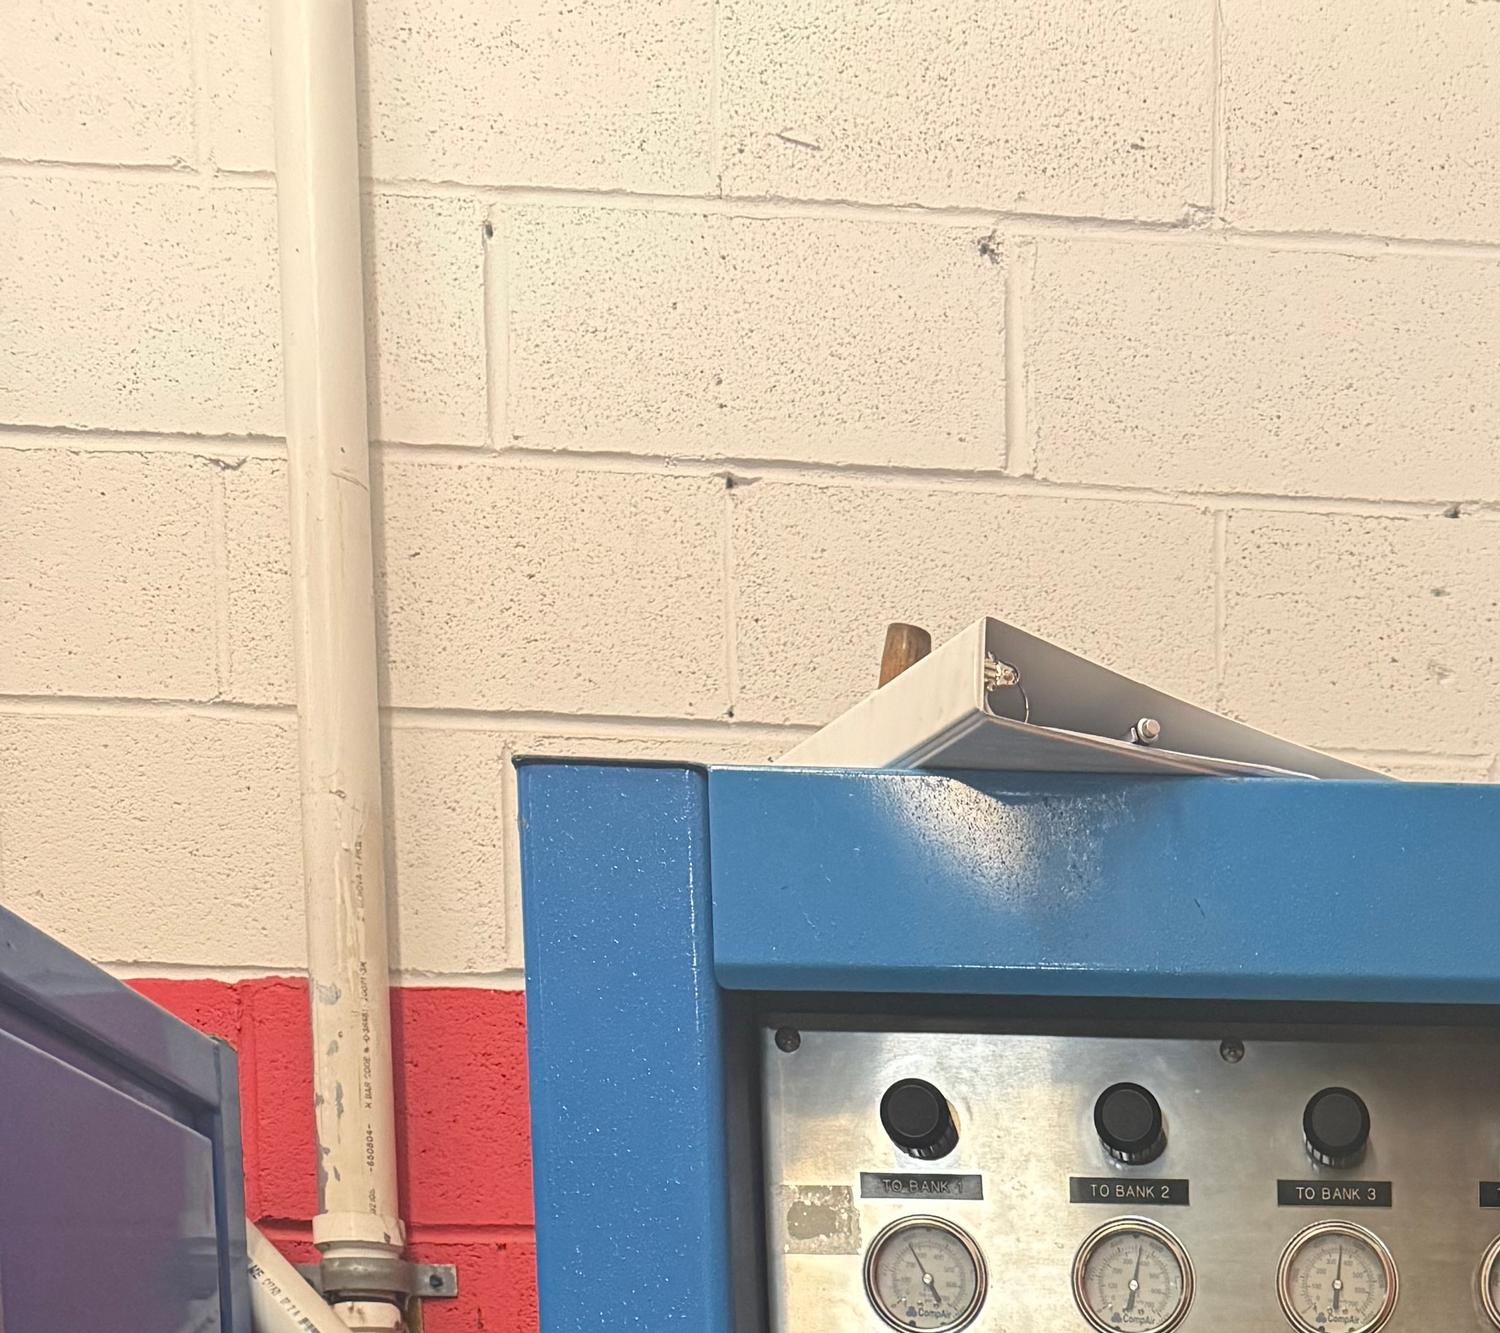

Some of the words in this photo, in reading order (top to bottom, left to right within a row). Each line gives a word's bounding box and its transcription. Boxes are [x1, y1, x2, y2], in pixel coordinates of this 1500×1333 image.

[882, 1179, 902, 1193] TO
[909, 1179, 950, 1194] BANK
[1090, 1184, 1110, 1197] TO
[1115, 1185, 1155, 1199] BANK
[1160, 1185, 1170, 1199] 2
[1295, 1186, 1316, 1200] TO
[1321, 1187, 1361, 1200] BANK
[1367, 1187, 1376, 1200] 3
